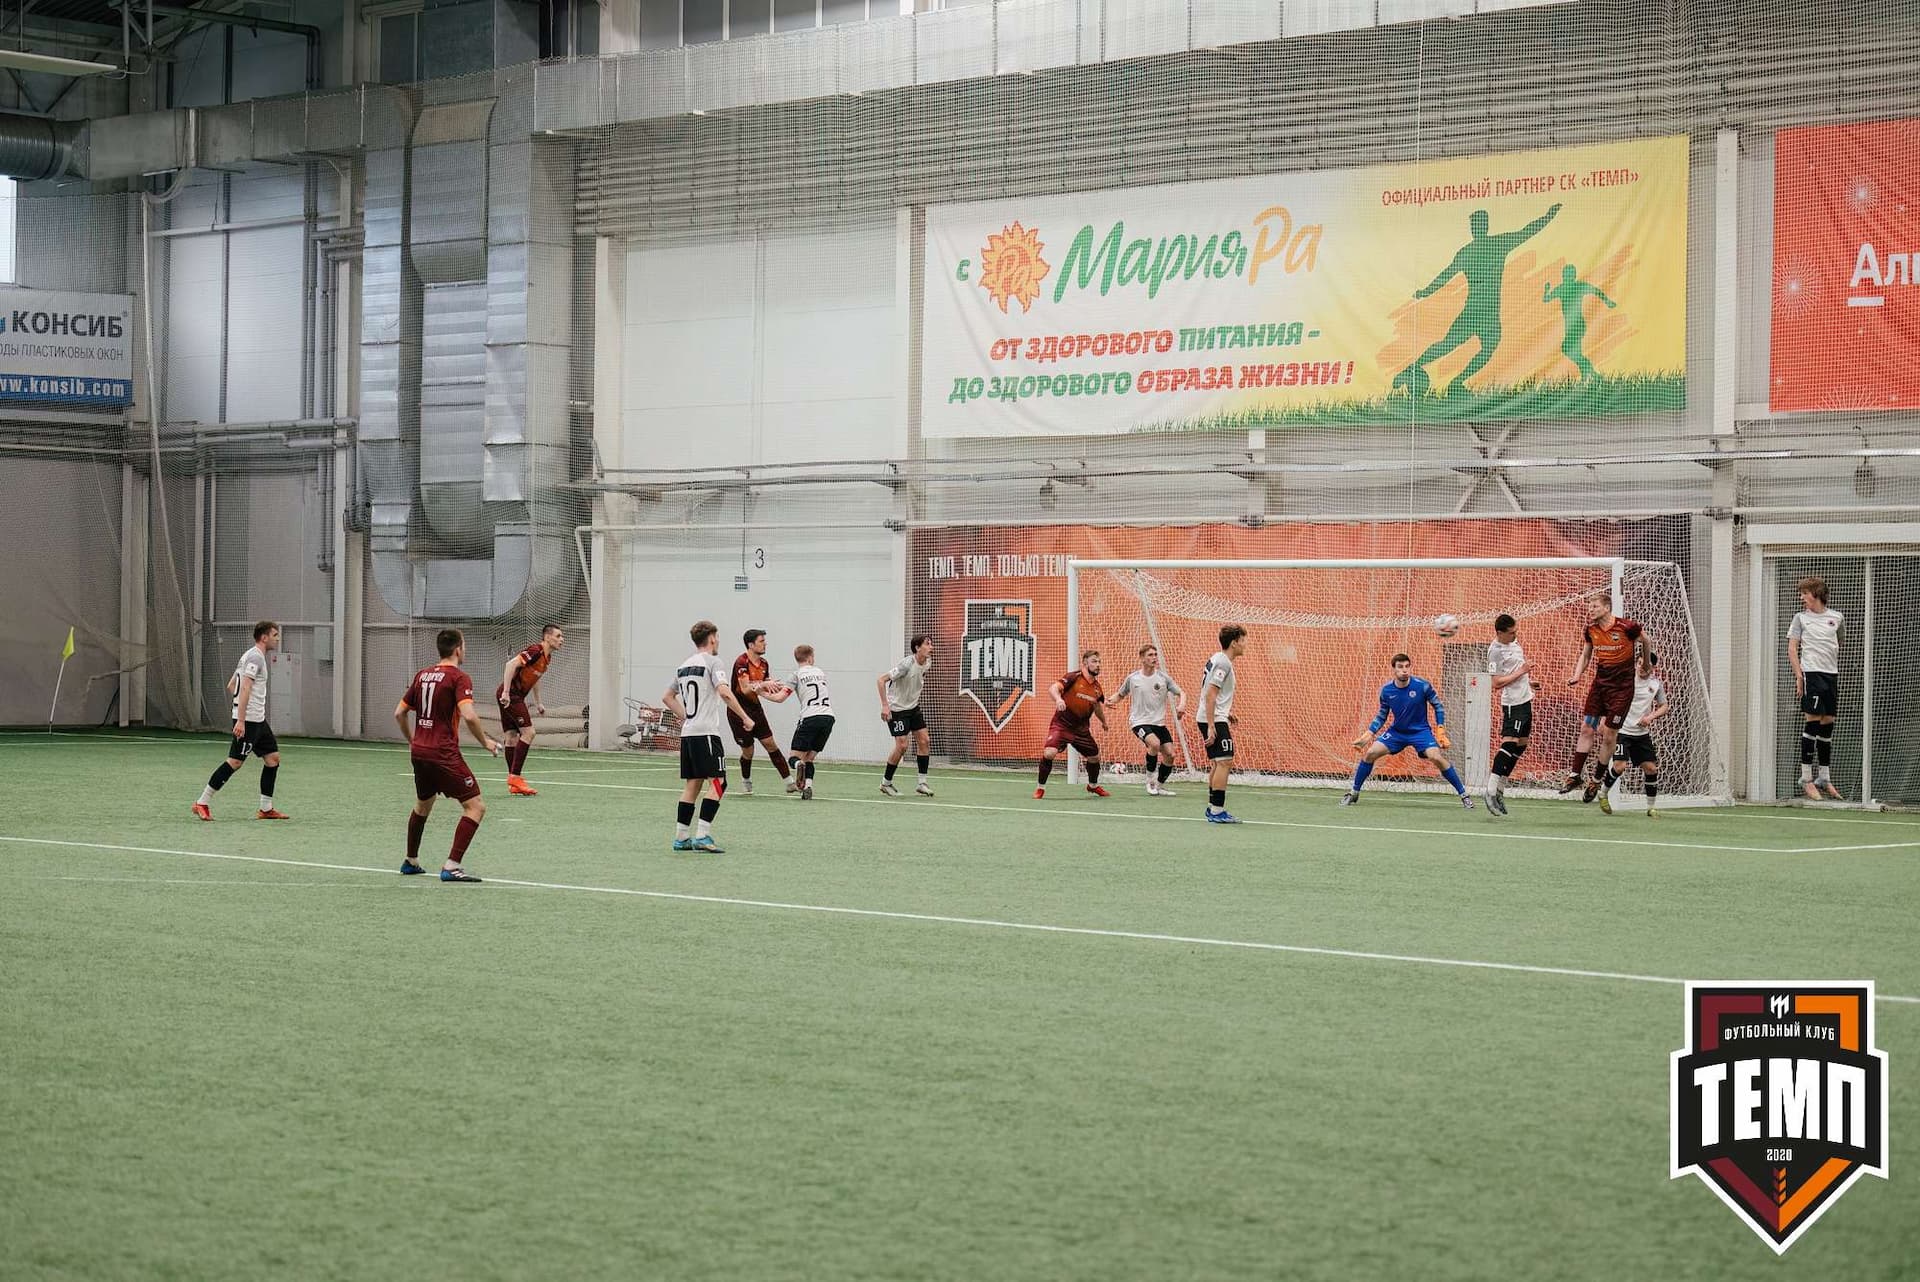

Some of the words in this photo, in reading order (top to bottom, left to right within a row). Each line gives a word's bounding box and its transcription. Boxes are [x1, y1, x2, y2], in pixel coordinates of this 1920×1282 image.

[1382, 178, 1491, 207] ОФИЦИАЛЬНЫЙ
[1496, 175, 1555, 197] ПАРТНЕР
[1559, 173, 1576, 191] СК
[1581, 168, 1640, 188] «ТЕМП»
[12, 310, 123, 338] КОНСИБ
[21, 344, 95, 359] ПЛАСТИКОВЫХ
[97, 347, 124, 360] ОКОН
[989, 337, 1023, 361] ОТ
[1025, 329, 1174, 363] ЗДОРОВОГО
[1178, 322, 1305, 352] ПИТАНИЯ
[949, 376, 984, 403] ДО
[987, 371, 1132, 402] ЗДОРОВОГО
[1137, 366, 1234, 394] ОБРАЗА
[755, 548, 765, 569] 3
[928, 556, 960, 579] ТЕМП,
[962, 555, 994, 580] ТЕМП,
[997, 554, 1039, 577] ТОЛЬКО
[967, 637, 1029, 682] ТЕМП
[421, 682, 436, 718] 11
[1812, 695, 1819, 709] 7
[893, 720, 905, 732] 28
[1514, 719, 1522, 733] 4
[1221, 738, 1233, 752] 91
[1614, 743, 1625, 756] 21
